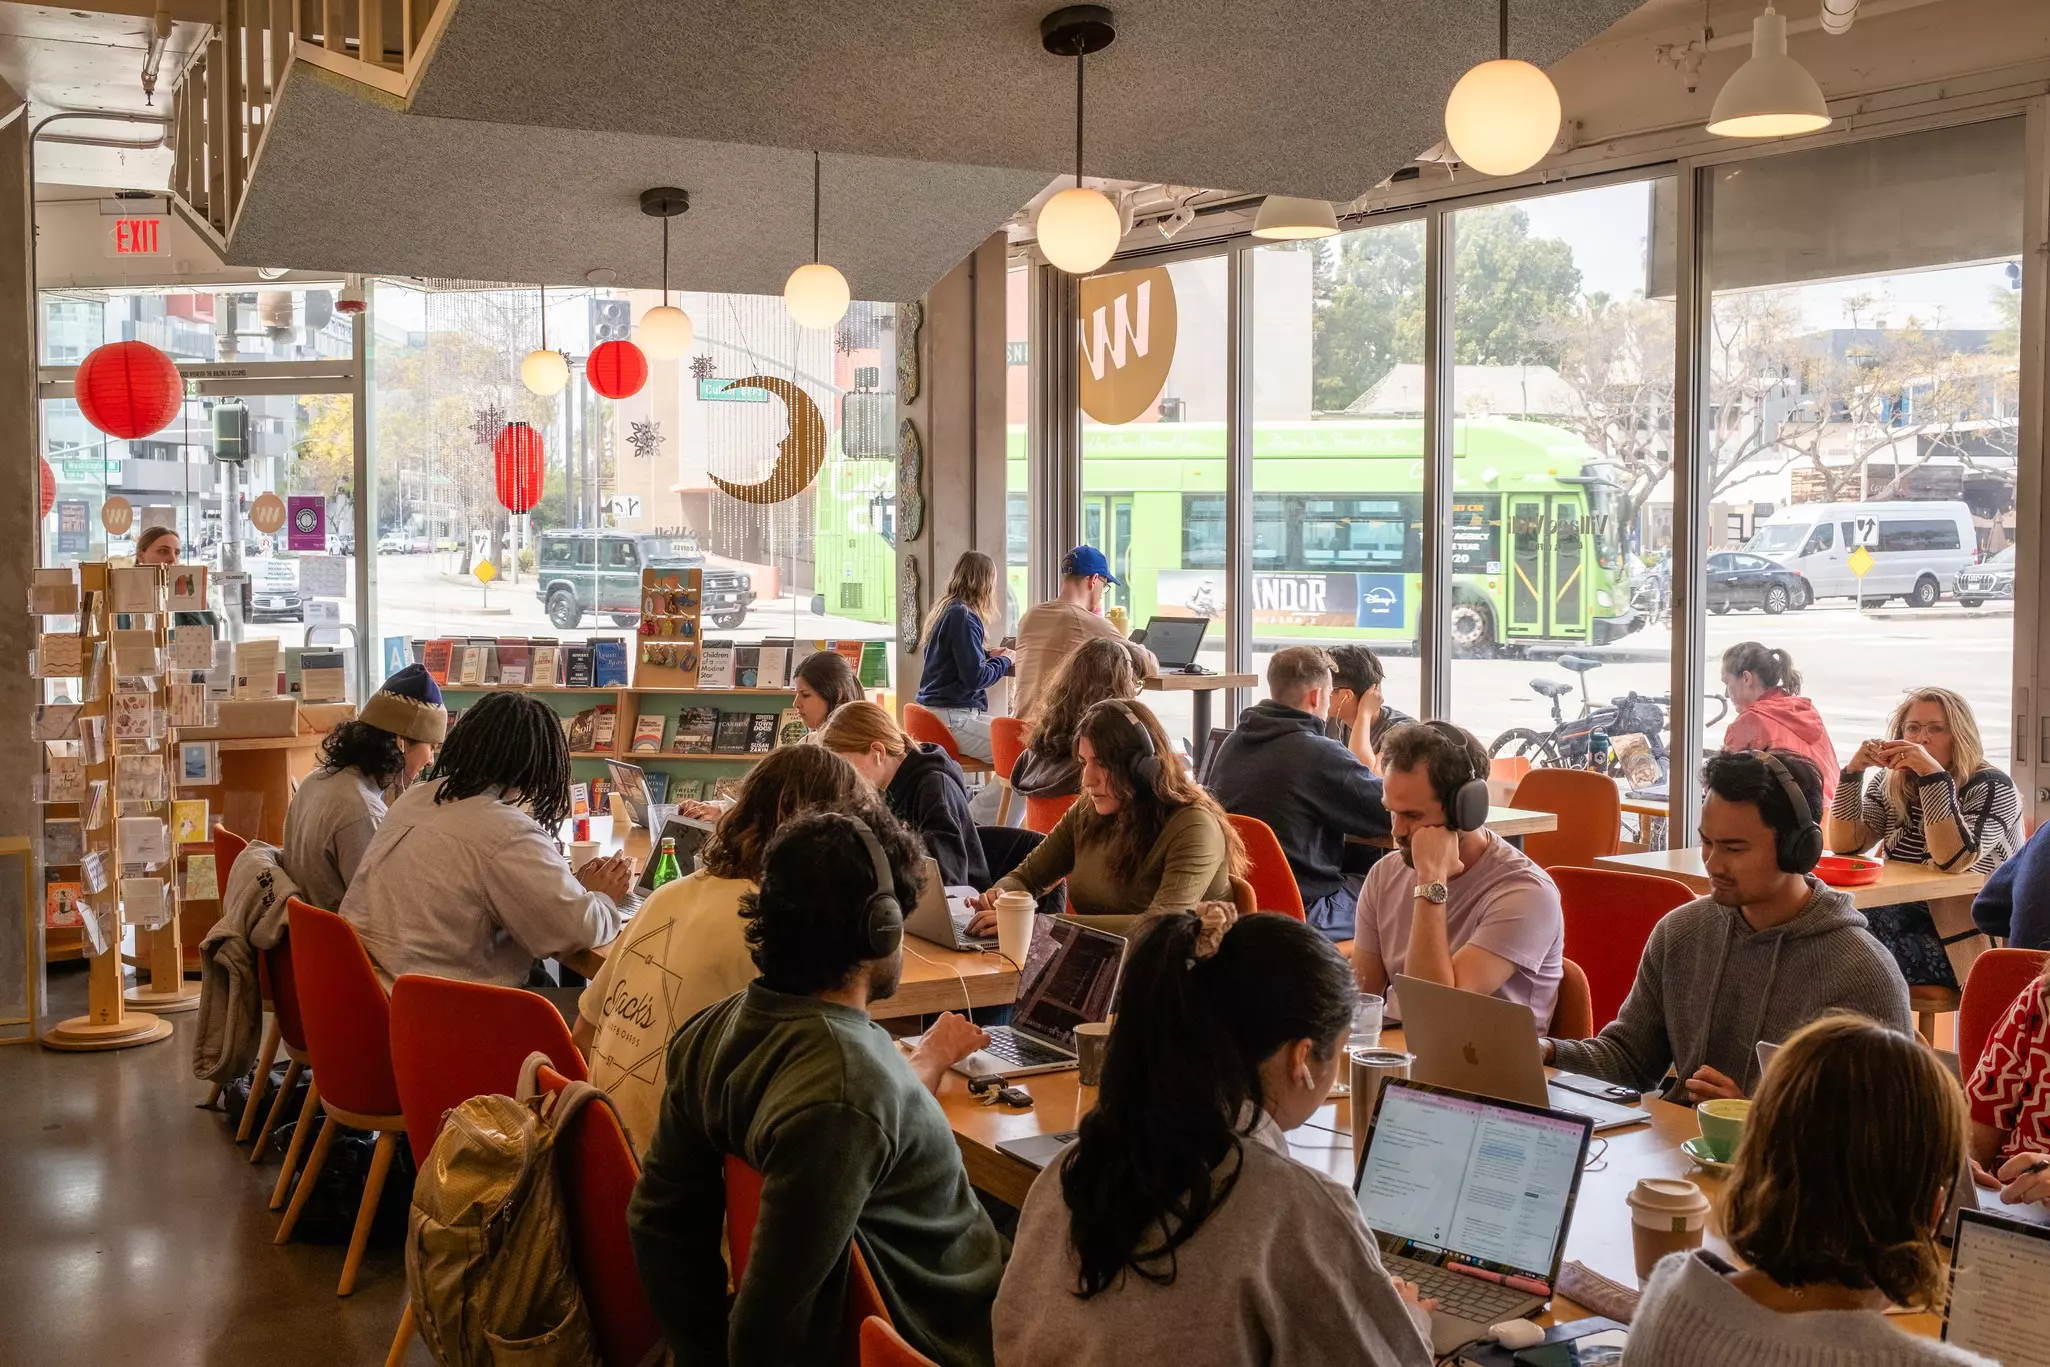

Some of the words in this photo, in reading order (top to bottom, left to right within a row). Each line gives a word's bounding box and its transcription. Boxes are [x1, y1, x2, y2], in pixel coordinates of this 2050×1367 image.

[116, 220, 160, 253] EXIT
[1458, 543, 1480, 551] YEAR
[1452, 554, 1470, 563] 20
[389, 646, 404, 672] A
[702, 651, 729, 659] Children
[575, 722, 592, 734] Soil
